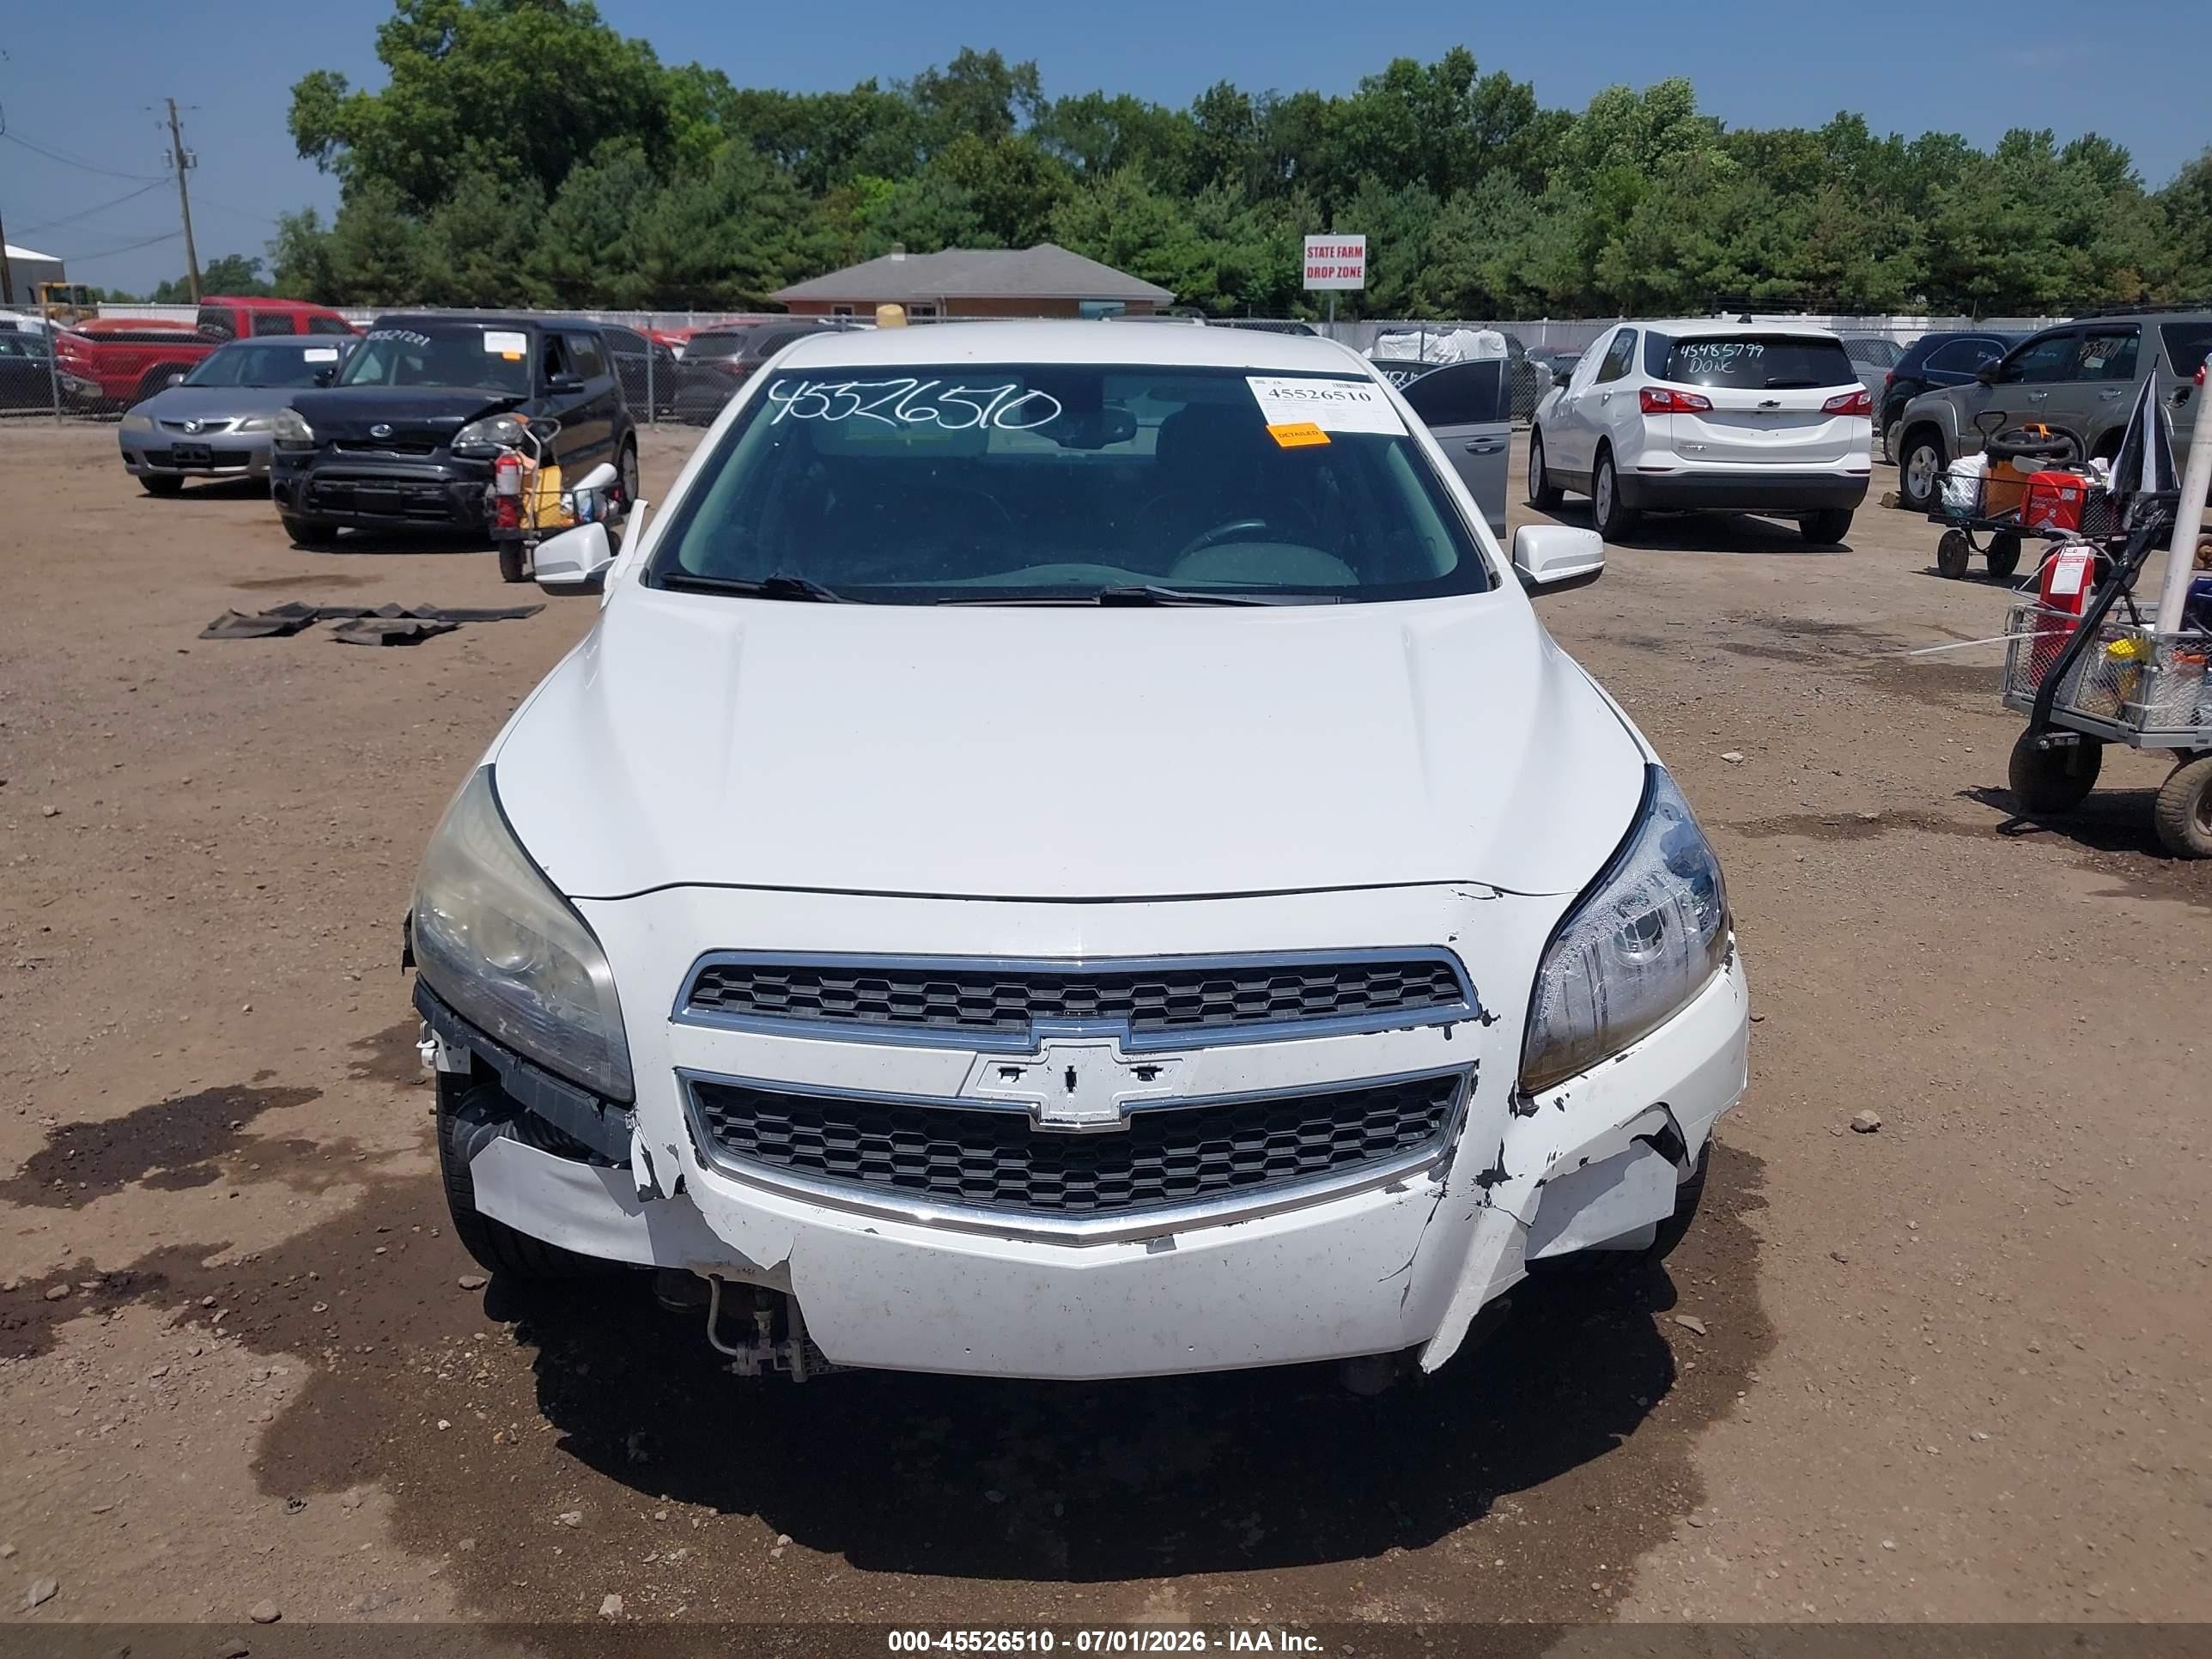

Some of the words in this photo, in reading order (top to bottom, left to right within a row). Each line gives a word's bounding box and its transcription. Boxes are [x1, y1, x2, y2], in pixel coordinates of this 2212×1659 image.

[1307, 246, 1334, 258] STATE
[1337, 246, 1363, 258] FARM
[1307, 266, 1334, 278] DROP
[1337, 266, 1363, 278] ZONE
[1680, 343, 1765, 359] 45485799
[1688, 356, 1735, 374] DONE
[1268, 388, 1372, 403] 45526510
[768, 378, 1062, 429] 45526510
[1278, 430, 1319, 439] DETAILED
